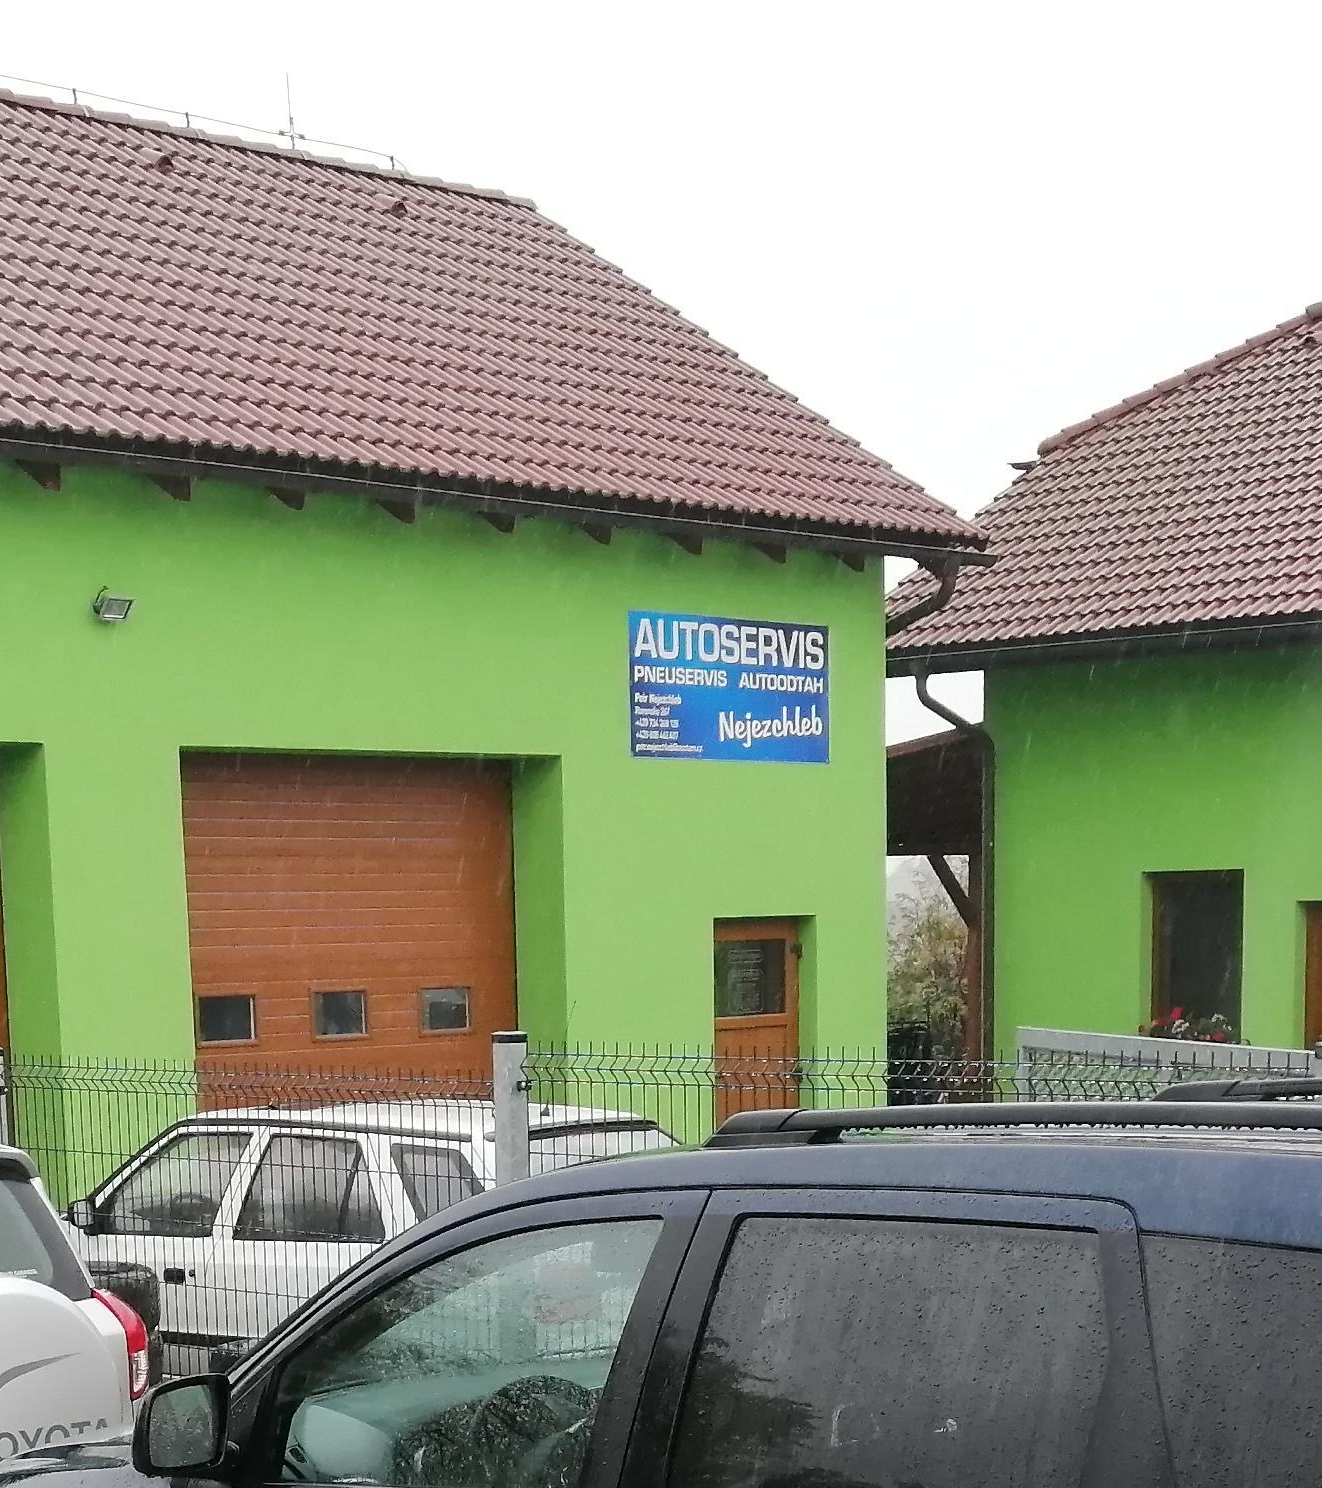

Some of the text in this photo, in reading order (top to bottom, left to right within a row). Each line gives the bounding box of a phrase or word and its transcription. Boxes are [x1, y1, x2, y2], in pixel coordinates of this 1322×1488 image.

[634, 618, 825, 670] AUTOSERVIS
[634, 665, 824, 694] PNEUSERVIS AUTOODTAH
[718, 704, 823, 748] Nejezchleb
